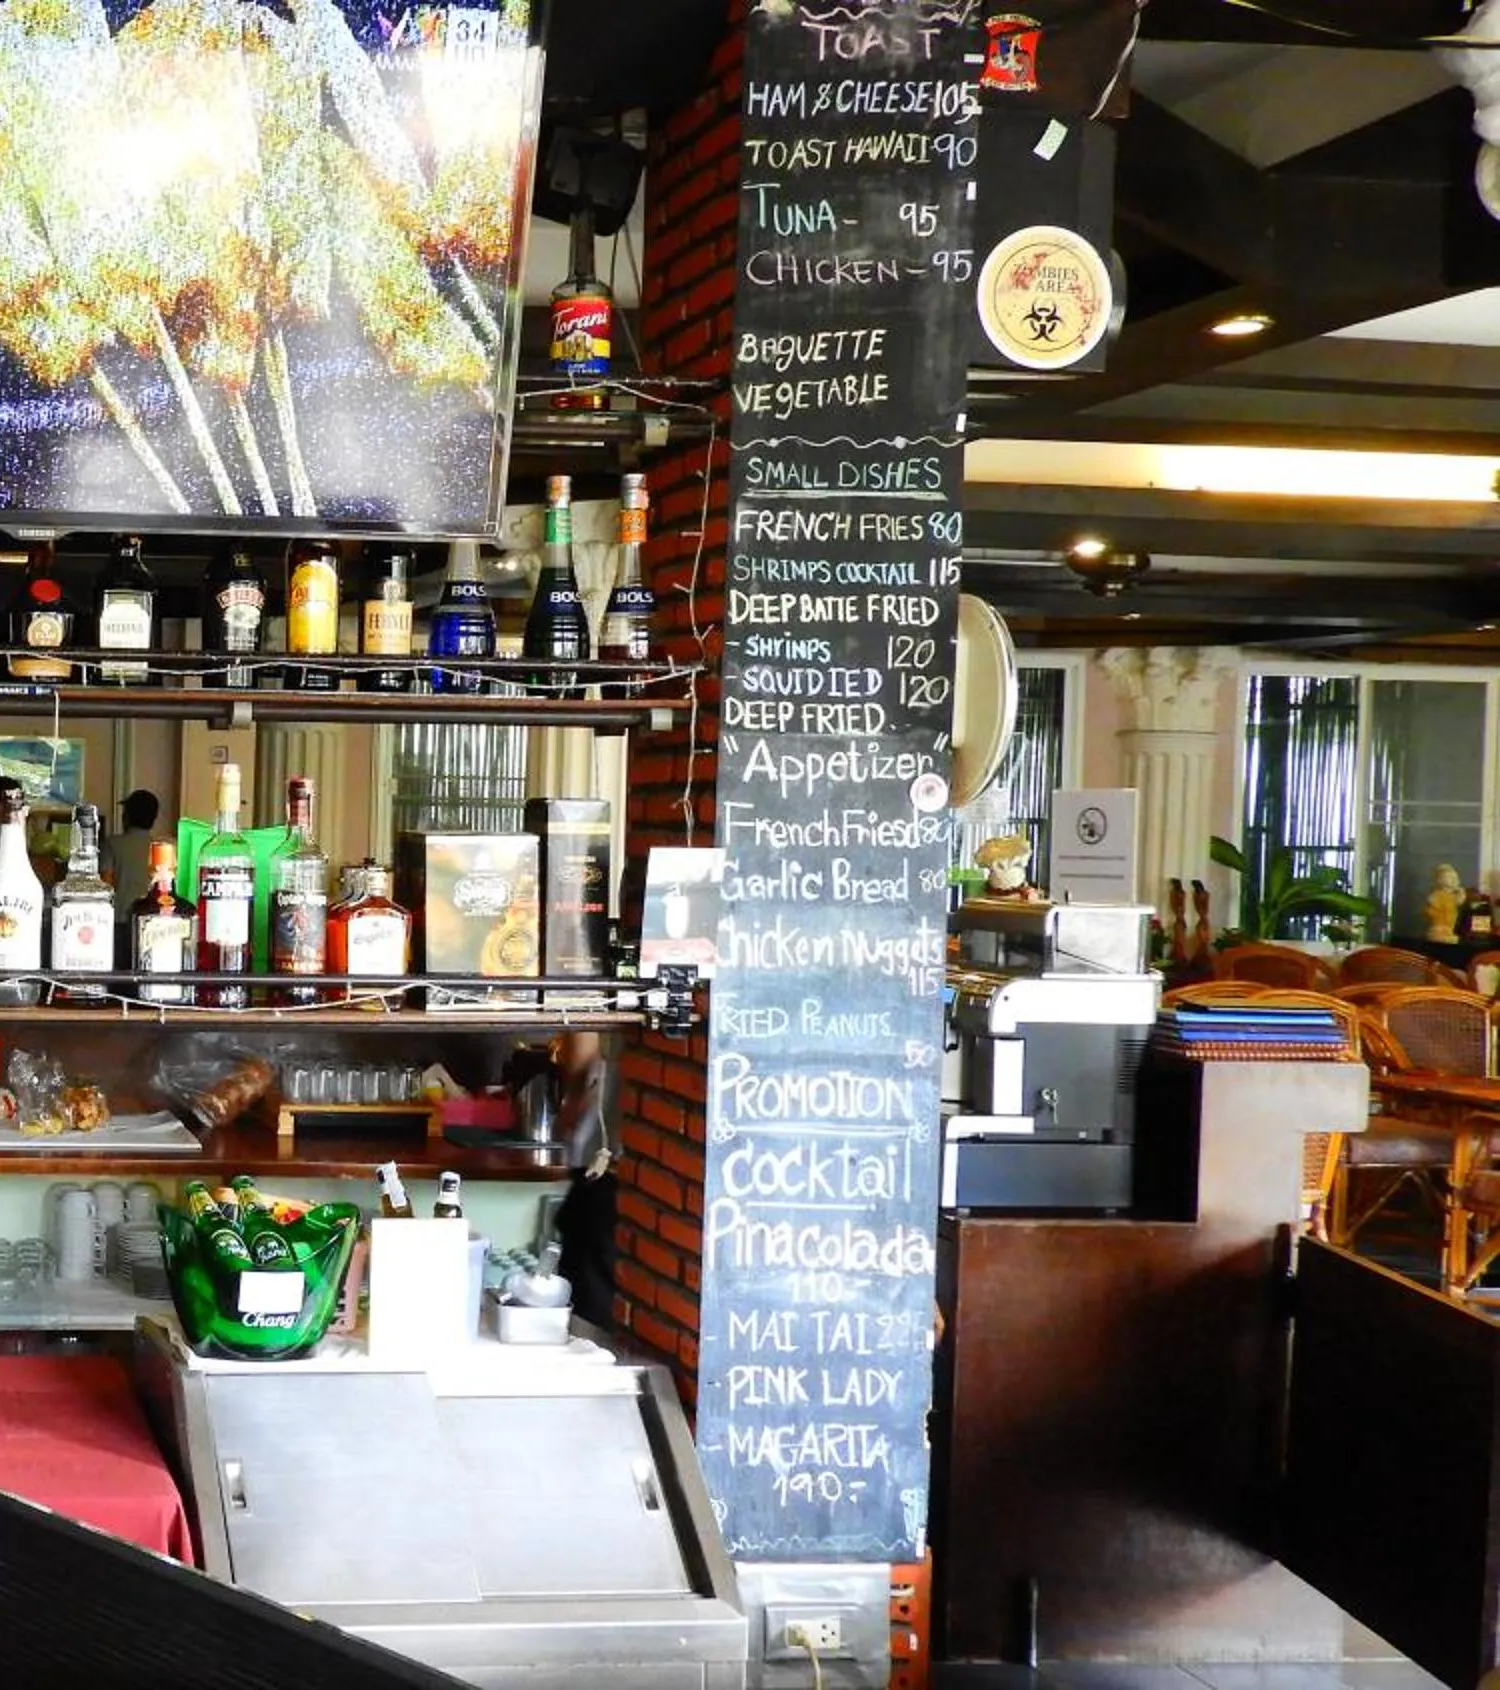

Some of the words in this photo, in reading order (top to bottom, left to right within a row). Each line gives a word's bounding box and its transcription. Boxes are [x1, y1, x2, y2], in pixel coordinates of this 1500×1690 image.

[801, 21, 941, 61] TOAST
[747, 81, 806, 118] HAM
[835, 80, 930, 116] CHEESE
[746, 139, 834, 171] TOAST
[900, 203, 940, 238] 95
[746, 250, 900, 286] CHICKEN
[552, 305, 609, 342] Torani
[746, 457, 828, 488] SMALL
[838, 457, 942, 489] DISHES
[734, 510, 851, 542] FRENCH
[860, 513, 924, 542] FRIES
[928, 512, 962, 545] 80
[734, 554, 830, 584] SHRIMPS
[836, 562, 922, 586] COCKTAIL
[451, 585, 488, 597] BOLS
[550, 591, 582, 604] BOLS
[617, 591, 654, 604] BOLS
[728, 589, 796, 625] DEEP
[867, 595, 940, 626] FRIED
[887, 635, 935, 670] 120
[900, 672, 949, 708] 120
[724, 696, 795, 732] DEEP
[724, 801, 840, 849] French
[720, 857, 823, 901] Garlic
[831, 857, 909, 902] Bread
[918, 868, 947, 894] 80
[718, 913, 833, 969] Chicken
[712, 1052, 913, 1121] PROMOTION
[241, 1311, 297, 1330] Chang
[729, 1310, 800, 1353] MAI
[810, 1310, 874, 1355] TAI
[727, 1365, 810, 1411] PINK
[822, 1368, 902, 1407] LADY
